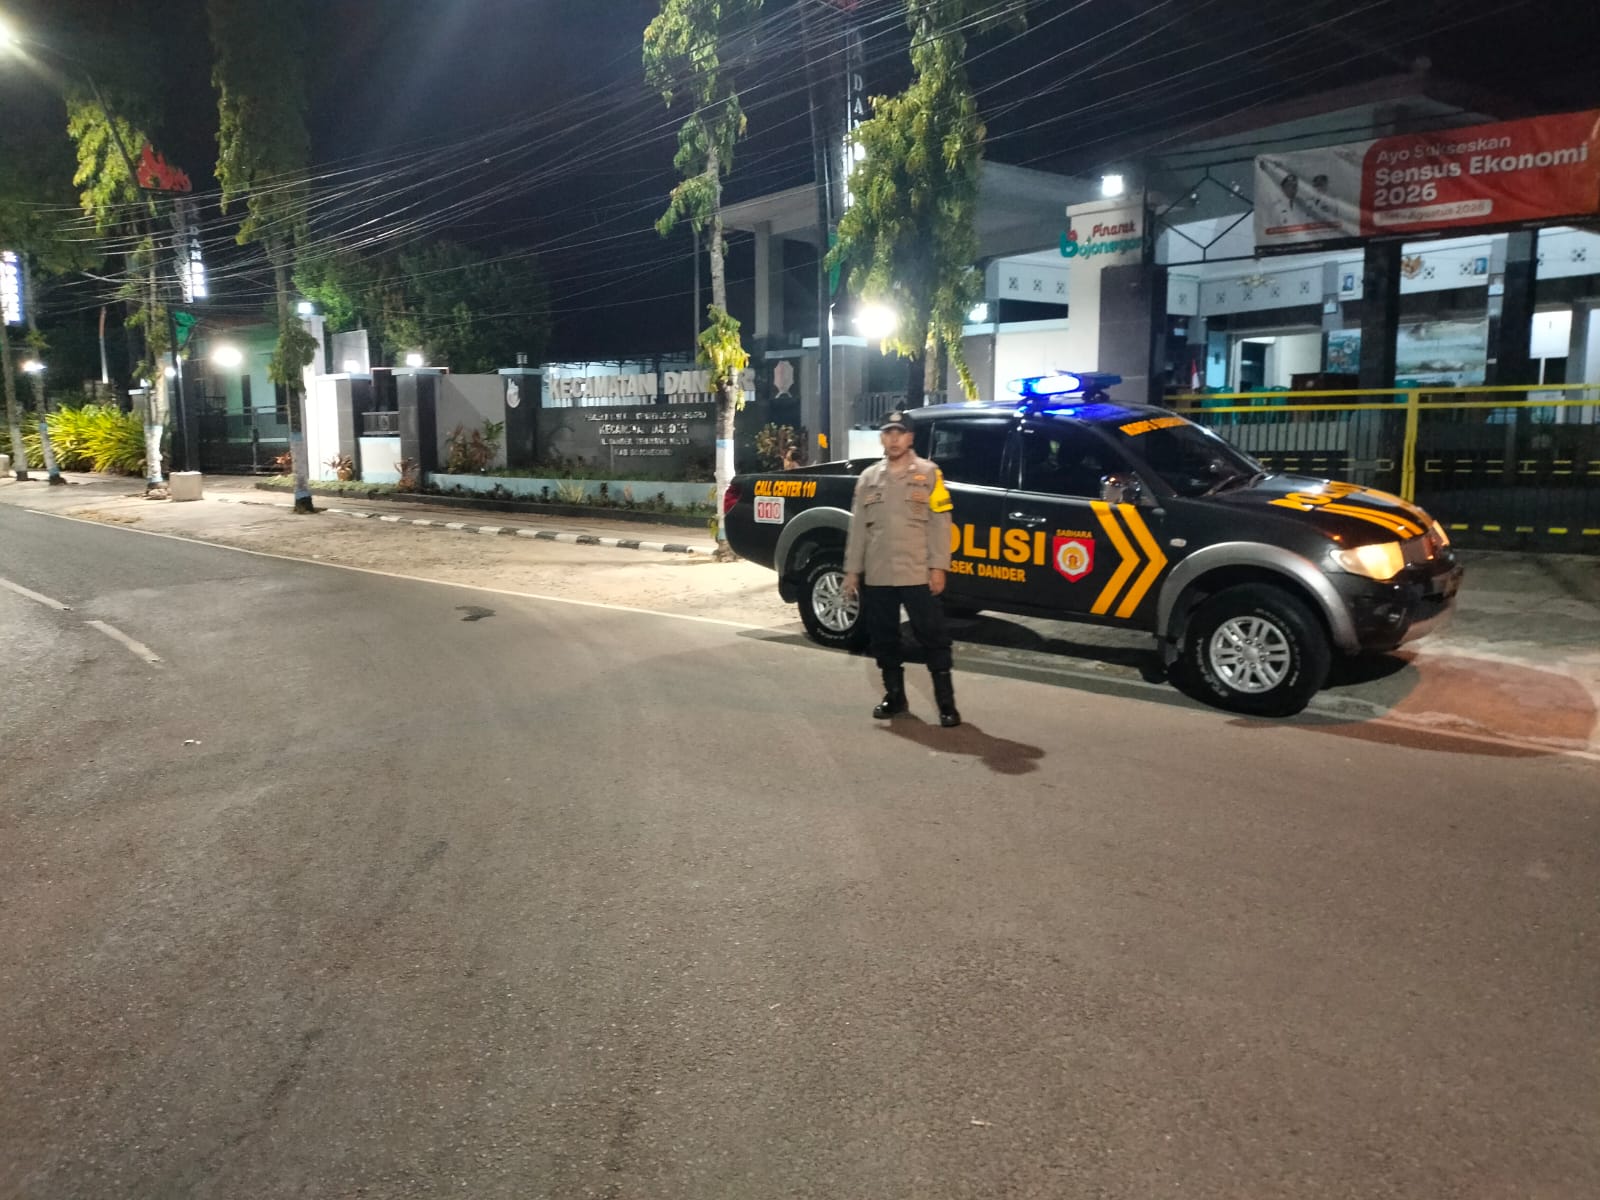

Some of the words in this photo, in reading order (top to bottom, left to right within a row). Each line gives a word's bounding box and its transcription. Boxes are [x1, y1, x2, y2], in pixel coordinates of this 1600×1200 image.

[1375, 162, 1462, 186] Sensus
[1469, 142, 1588, 175] Ekonomi
[1376, 149, 1410, 165] Ayo
[1374, 182, 1437, 207] 2026
[550, 373, 657, 398] KECAMATAN
[664, 367, 757, 396] DANR
[754, 480, 773, 497] CALL
[773, 480, 803, 497] CENTER
[802, 480, 818, 498] 110
[757, 502, 781, 519] 110
[950, 522, 1047, 566] LISI
[950, 560, 975, 576] SEK
[977, 563, 1026, 582] DANDER
